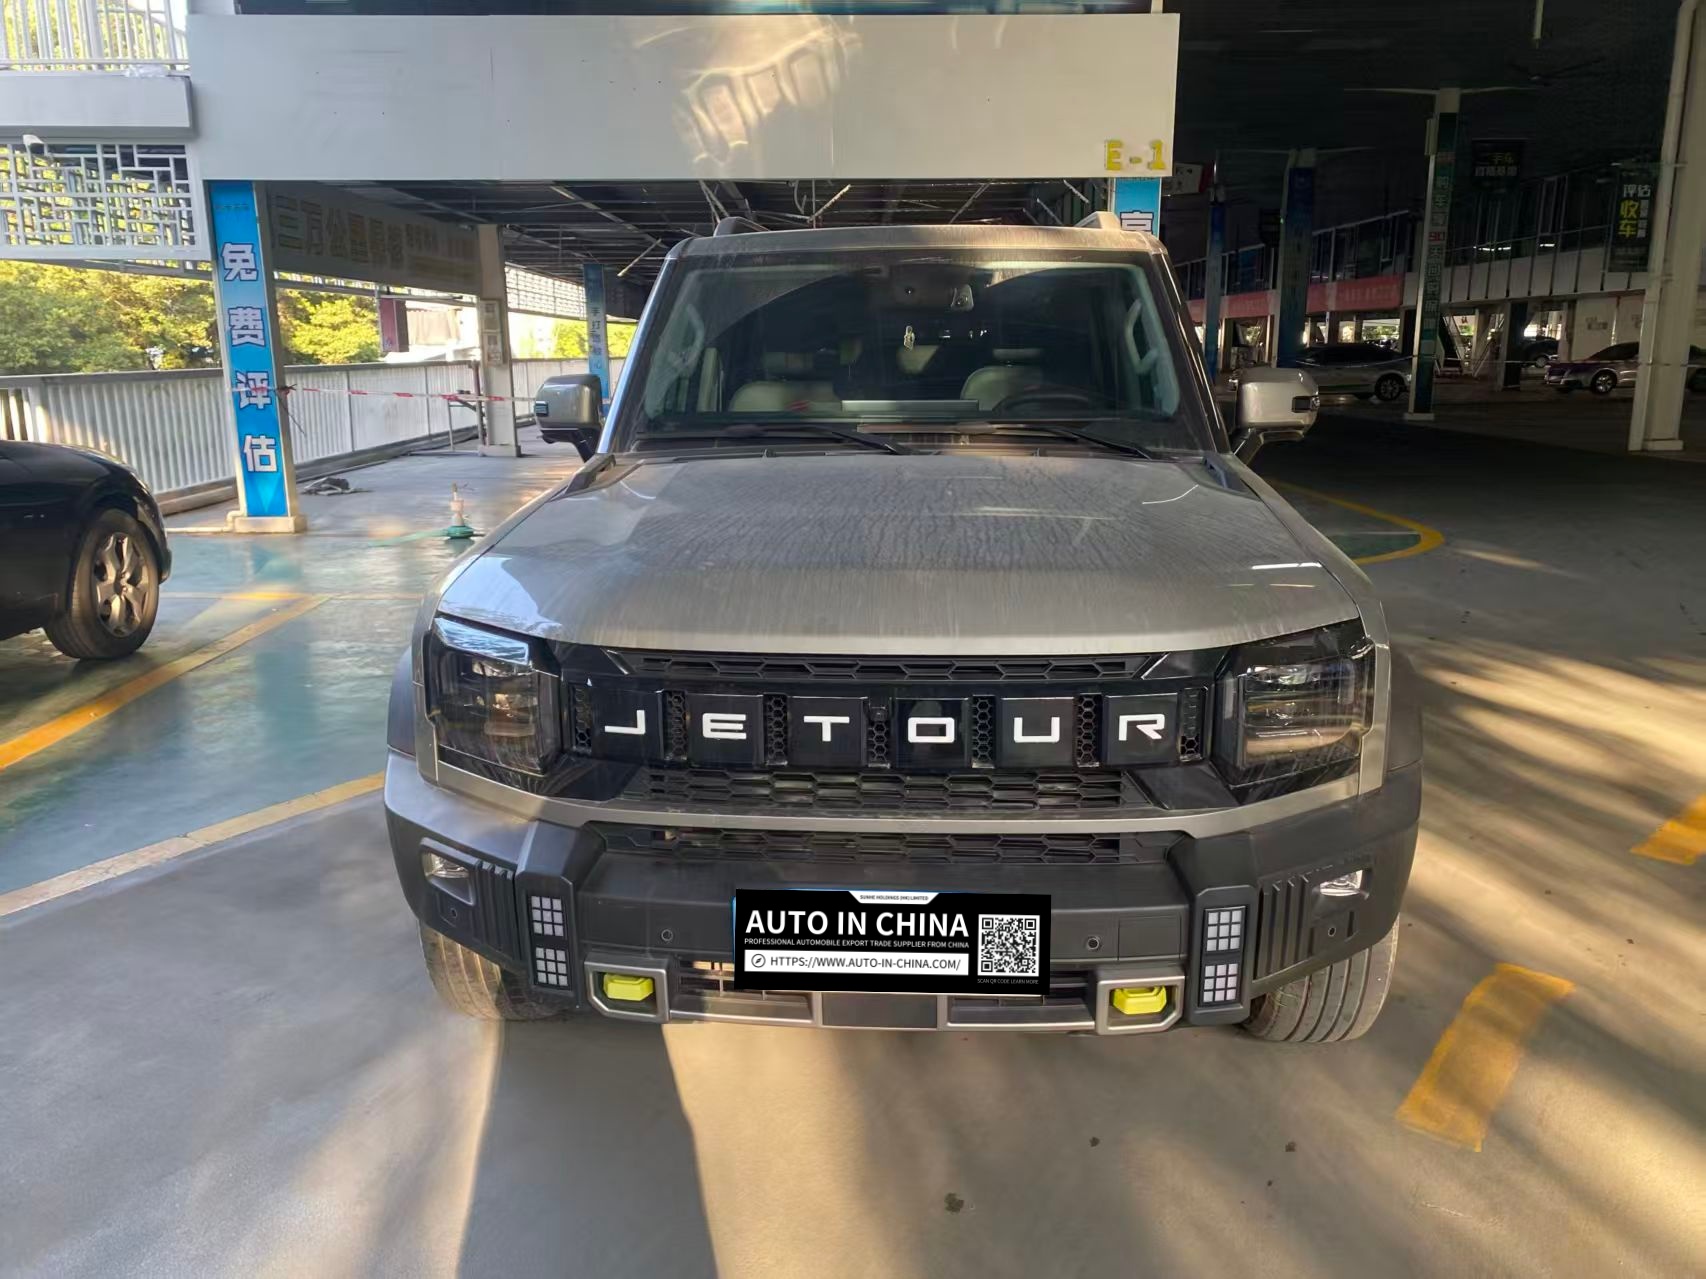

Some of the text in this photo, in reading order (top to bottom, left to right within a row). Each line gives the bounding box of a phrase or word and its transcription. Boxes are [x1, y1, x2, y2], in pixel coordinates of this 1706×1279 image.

[1105, 139, 1167, 170] E-1
[220, 242, 278, 473] 免费评估
[604, 709, 1167, 744] JETOUR
